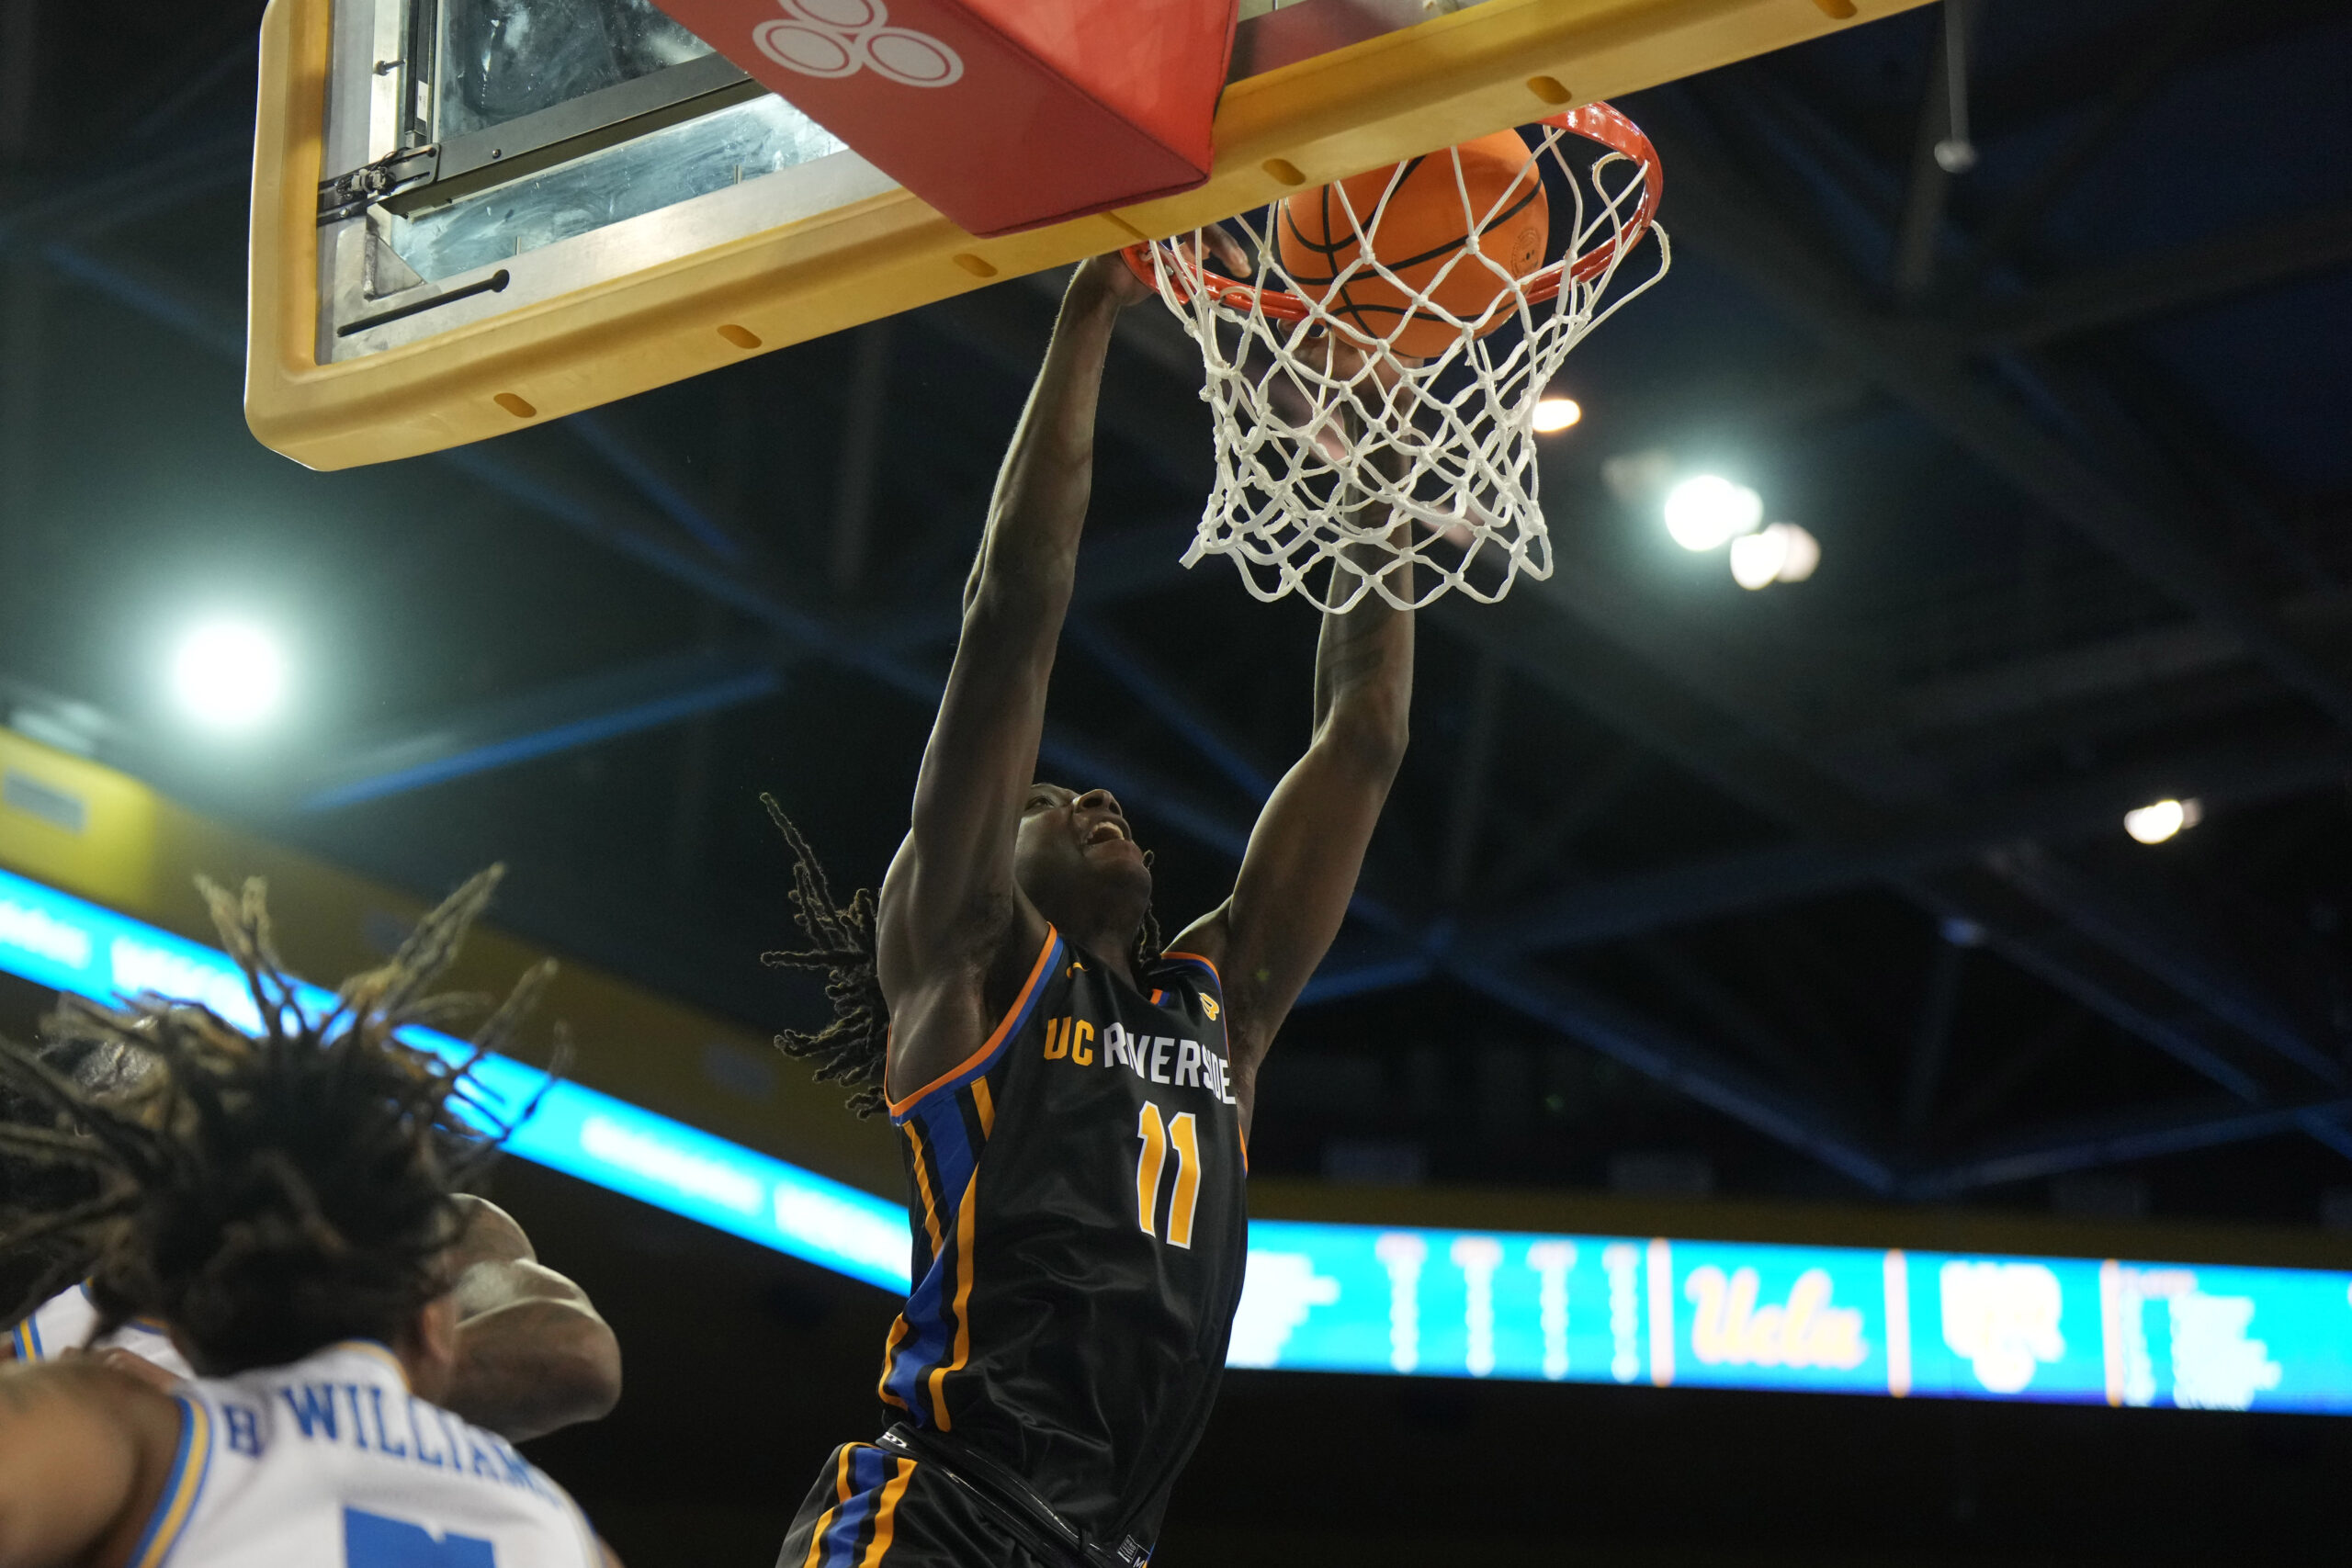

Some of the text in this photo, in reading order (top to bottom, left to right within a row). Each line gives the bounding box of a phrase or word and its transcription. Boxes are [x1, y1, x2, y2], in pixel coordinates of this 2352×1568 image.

[1044, 1016, 1237, 1105] UC RIVERSIDE
[1136, 1100, 1201, 1249] 11
[281, 1384, 562, 1510] WILLIAM
